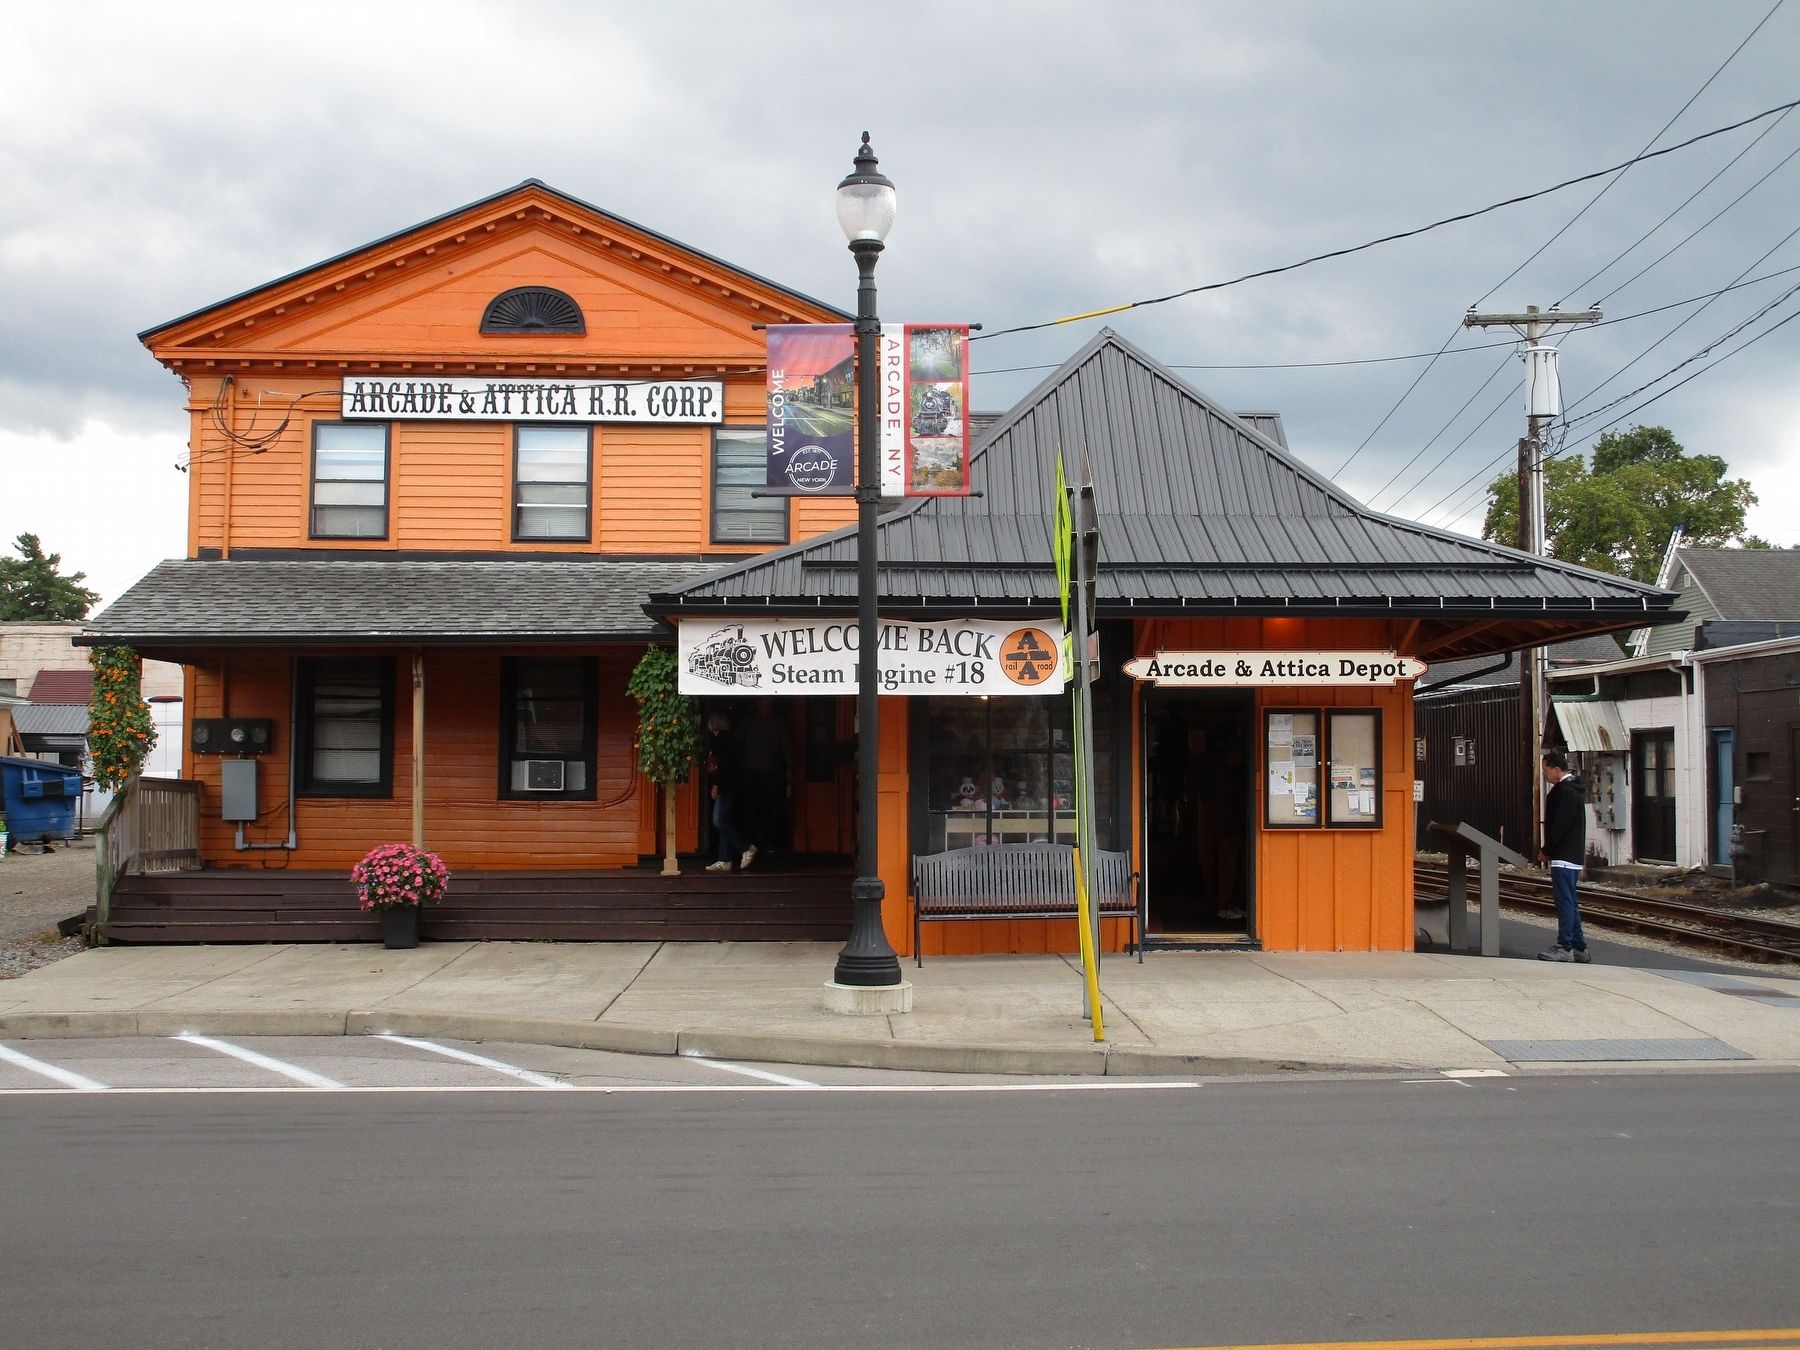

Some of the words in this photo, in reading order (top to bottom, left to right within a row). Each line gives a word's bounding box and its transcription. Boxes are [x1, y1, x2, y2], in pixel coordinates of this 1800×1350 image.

[349, 381, 453, 414] ARCADE
[458, 389, 476, 414] &
[480, 383, 578, 415] ATTICA
[587, 384, 637, 417] R.R.
[646, 385, 717, 417] CORP.
[886, 339, 901, 437] ARCADE,
[772, 369, 785, 456] WELCOME
[784, 459, 838, 474] ARCADE
[888, 448, 901, 477] NY
[917, 627, 995, 660] BACK
[771, 663, 845, 684] Steam
[944, 661, 985, 684] #18
[1005, 661, 1018, 671] rail
[1037, 661, 1053, 671] road
[1146, 659, 1226, 677] Arcade
[1234, 660, 1253, 677] &
[1260, 659, 1331, 677] Attica
[1338, 659, 1407, 682] Depot
